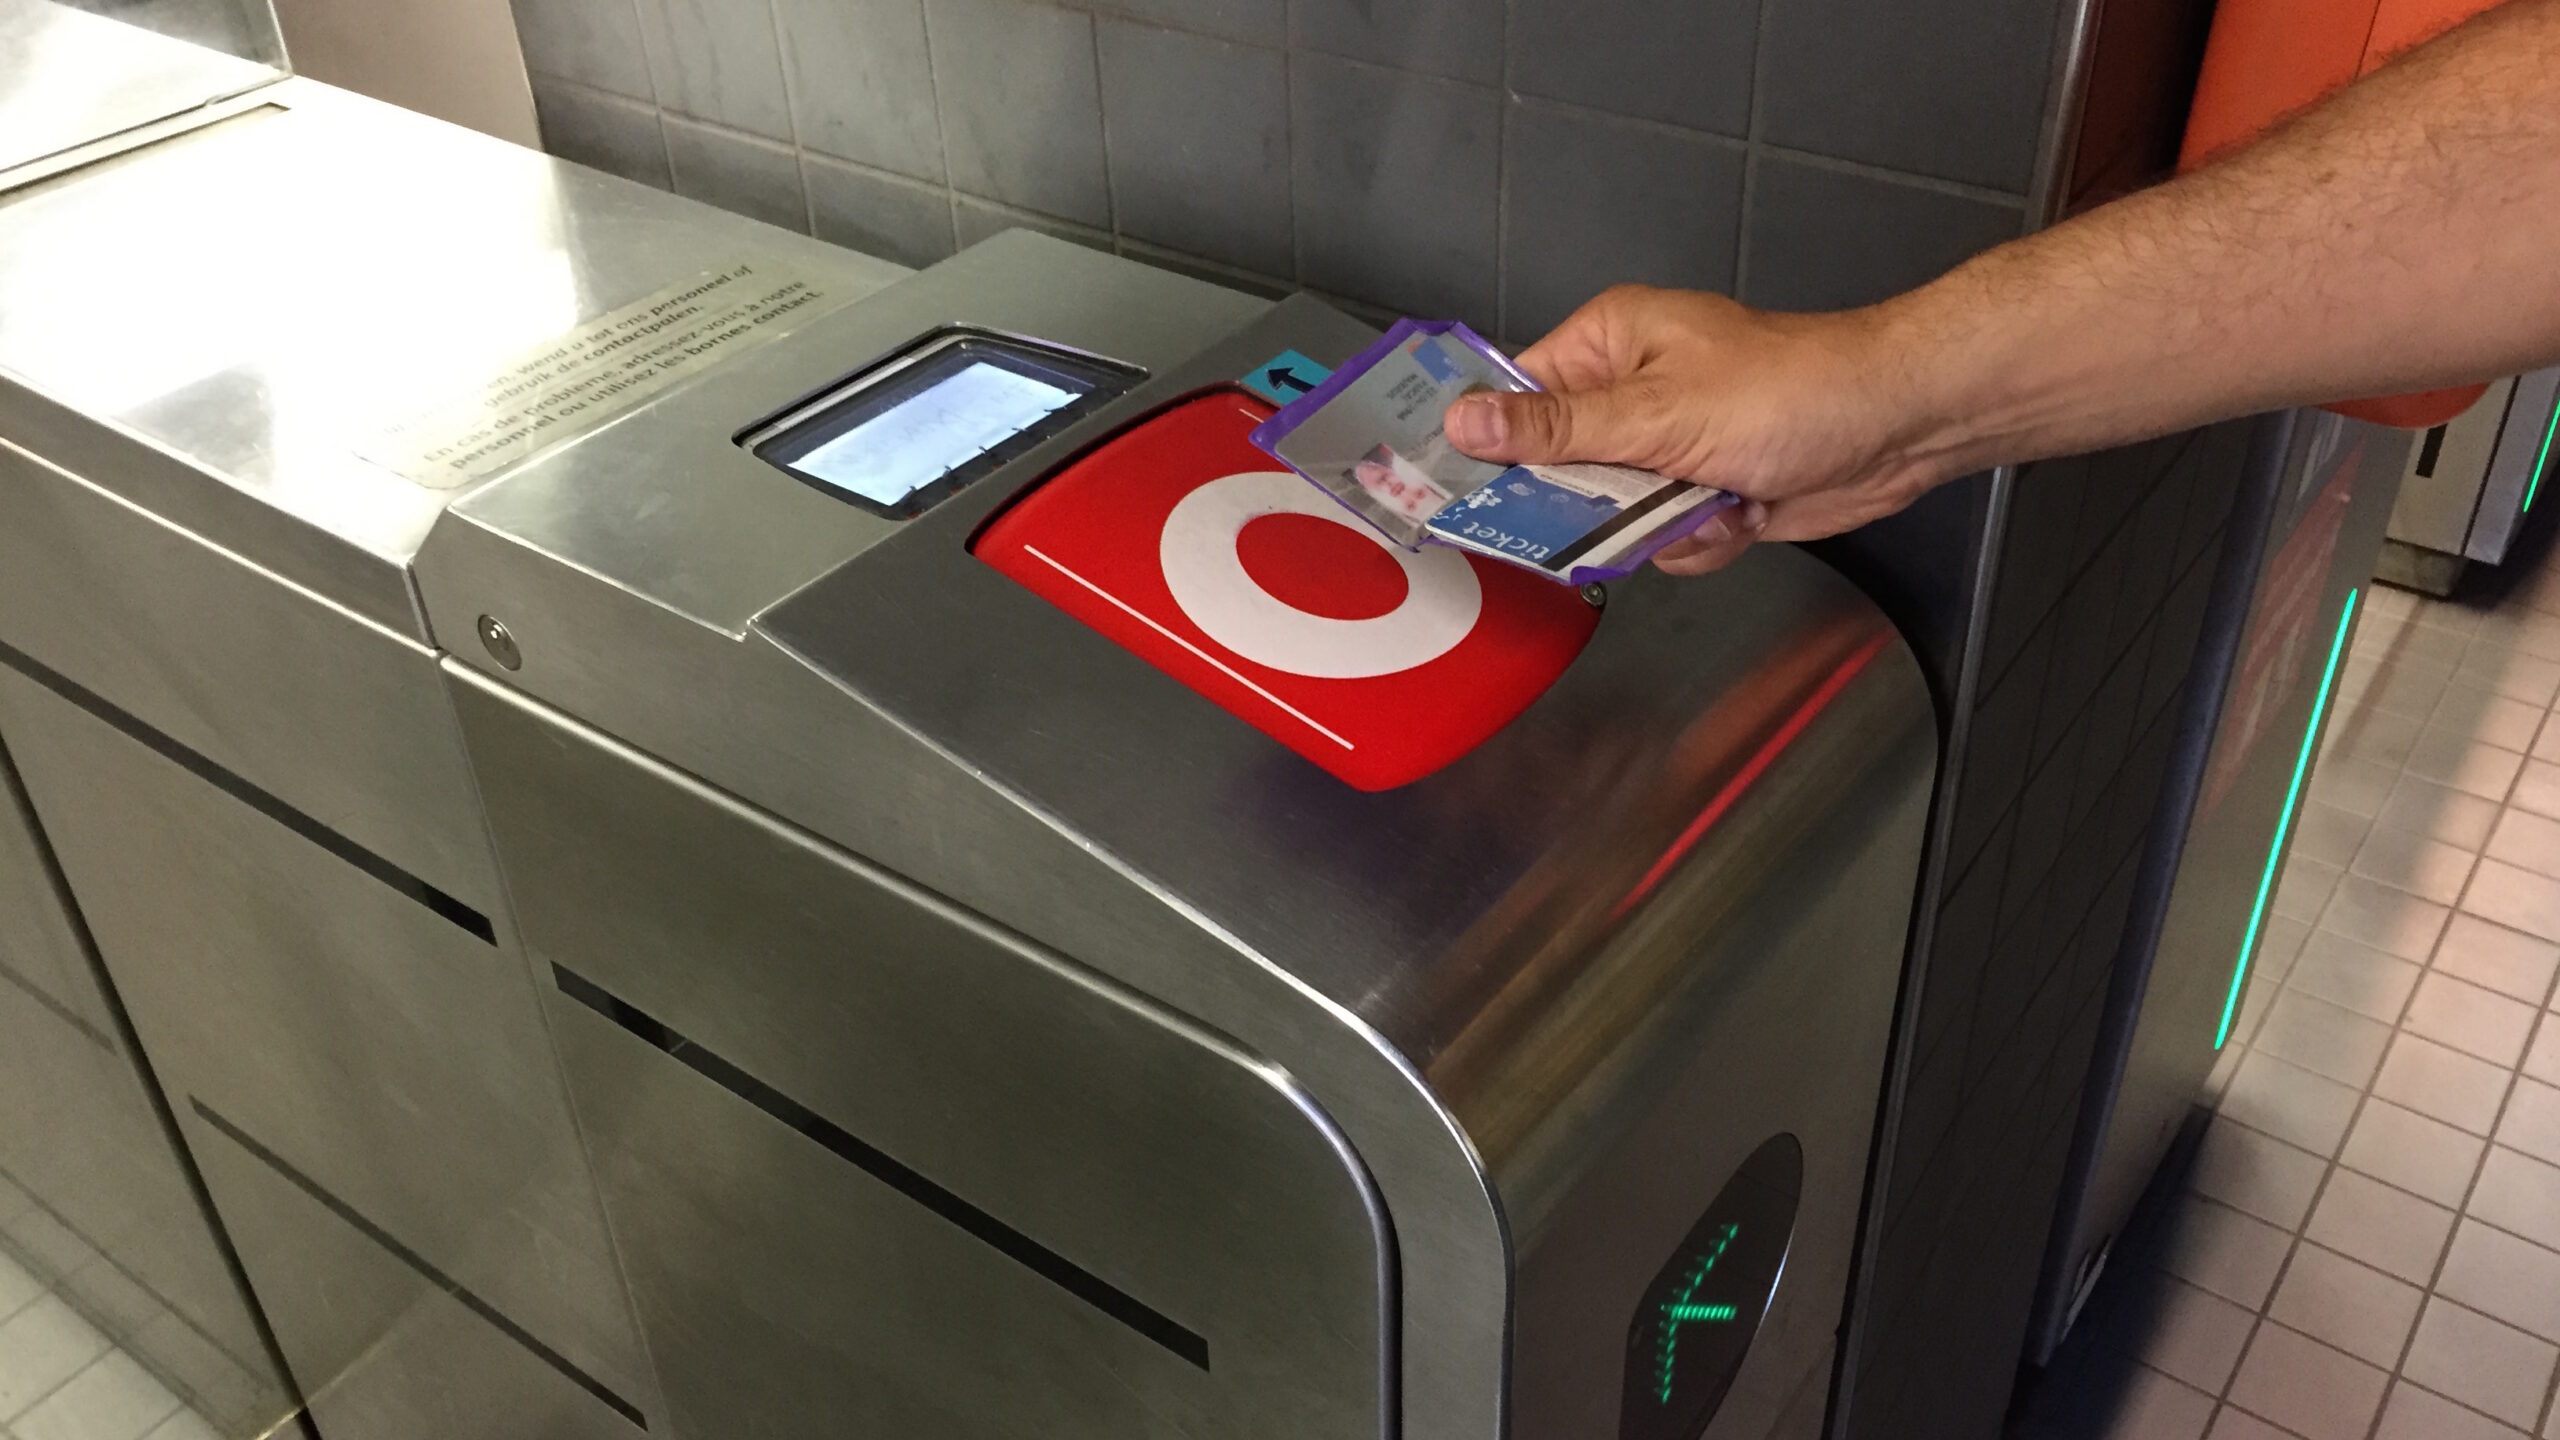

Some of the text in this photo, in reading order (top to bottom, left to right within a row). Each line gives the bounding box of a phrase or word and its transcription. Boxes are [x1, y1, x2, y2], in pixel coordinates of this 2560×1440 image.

[424, 447, 453, 462] En
[457, 430, 492, 447] cas
[494, 415, 521, 429] de
[760, 281, 806, 305] notre
[484, 372, 555, 408] gebruik
[557, 360, 581, 373] de
[584, 306, 703, 361] contactpalen.
[516, 348, 568, 374] wend
[586, 328, 615, 343] tot
[616, 314, 648, 330] ons
[650, 274, 732, 316] personeel
[733, 264, 752, 278] of
[450, 415, 558, 469] personnel
[560, 401, 588, 416] ou
[589, 368, 657, 402] utilisez
[654, 354, 686, 369] les
[684, 324, 751, 355] bornes
[1462, 521, 1550, 559] ticket
